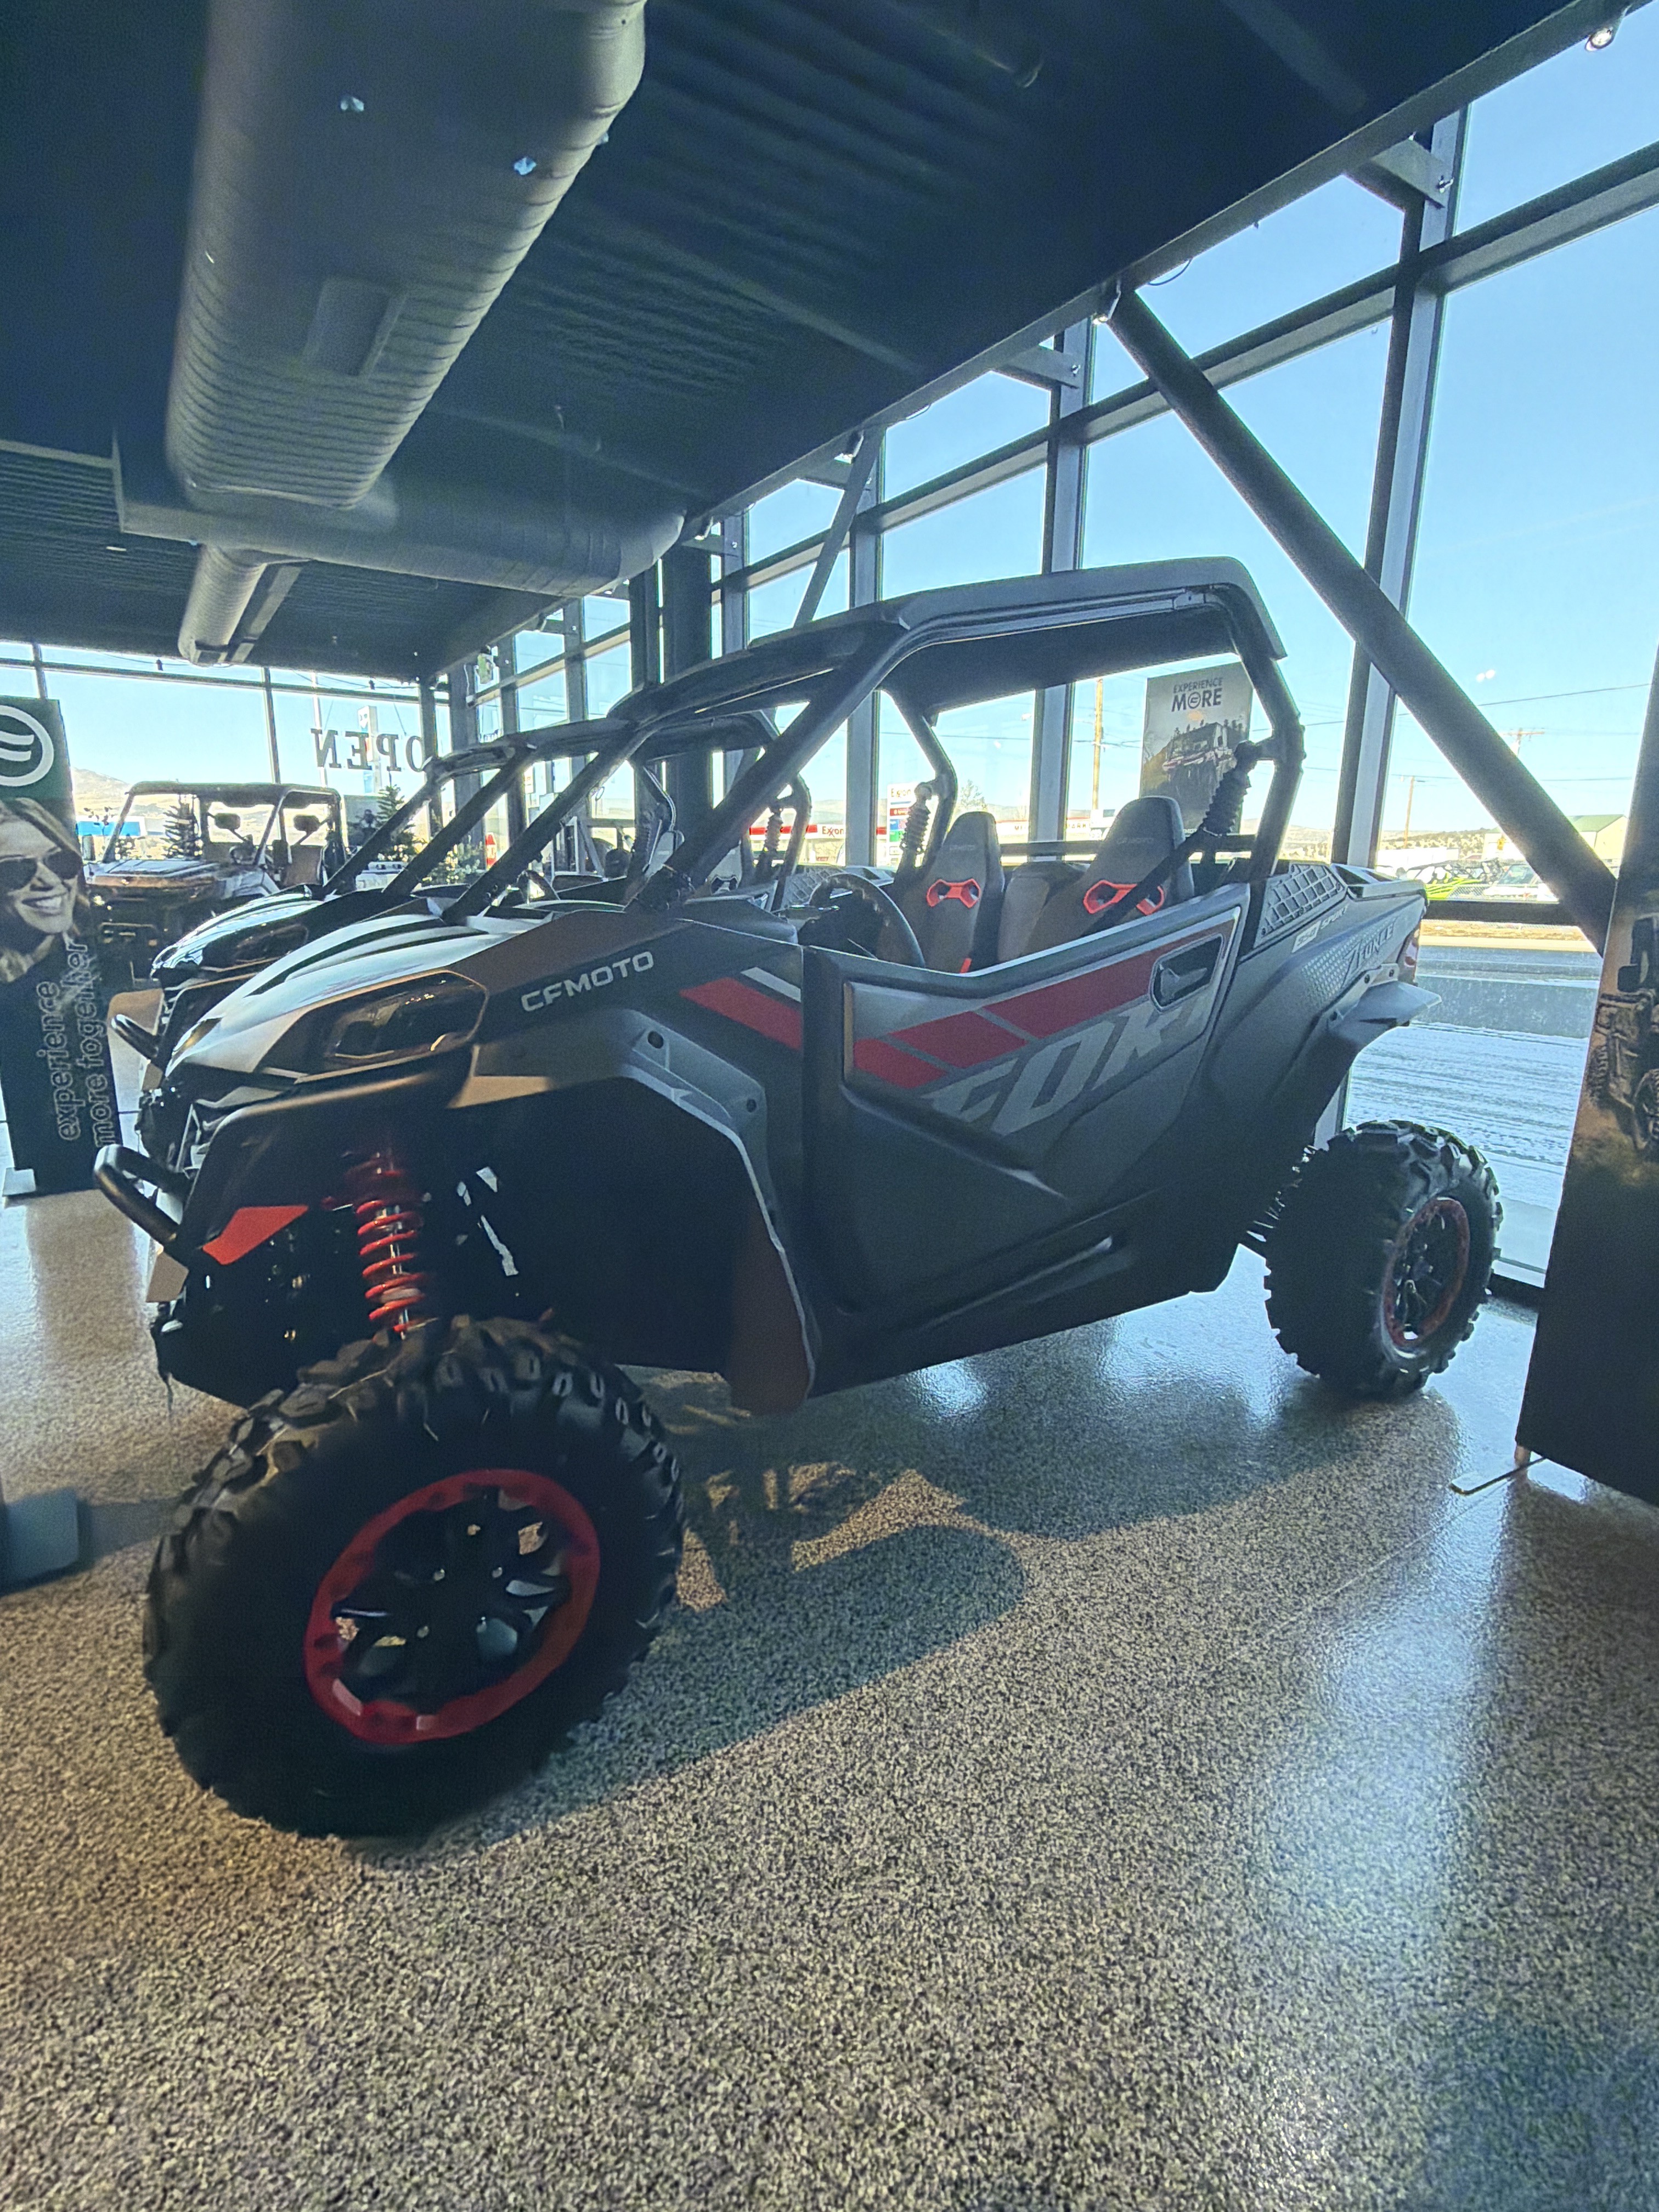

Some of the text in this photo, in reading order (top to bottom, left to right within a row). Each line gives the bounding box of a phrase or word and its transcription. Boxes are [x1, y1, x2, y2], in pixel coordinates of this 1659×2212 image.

[1171, 688, 1223, 712] MORE
[1173, 678, 1223, 693] EXPERIENCE
[822, 826, 845, 838] Exxon
[521, 951, 654, 1012] CFMOTO
[36, 981, 86, 1141] experience
[86, 1073, 116, 1148] more
